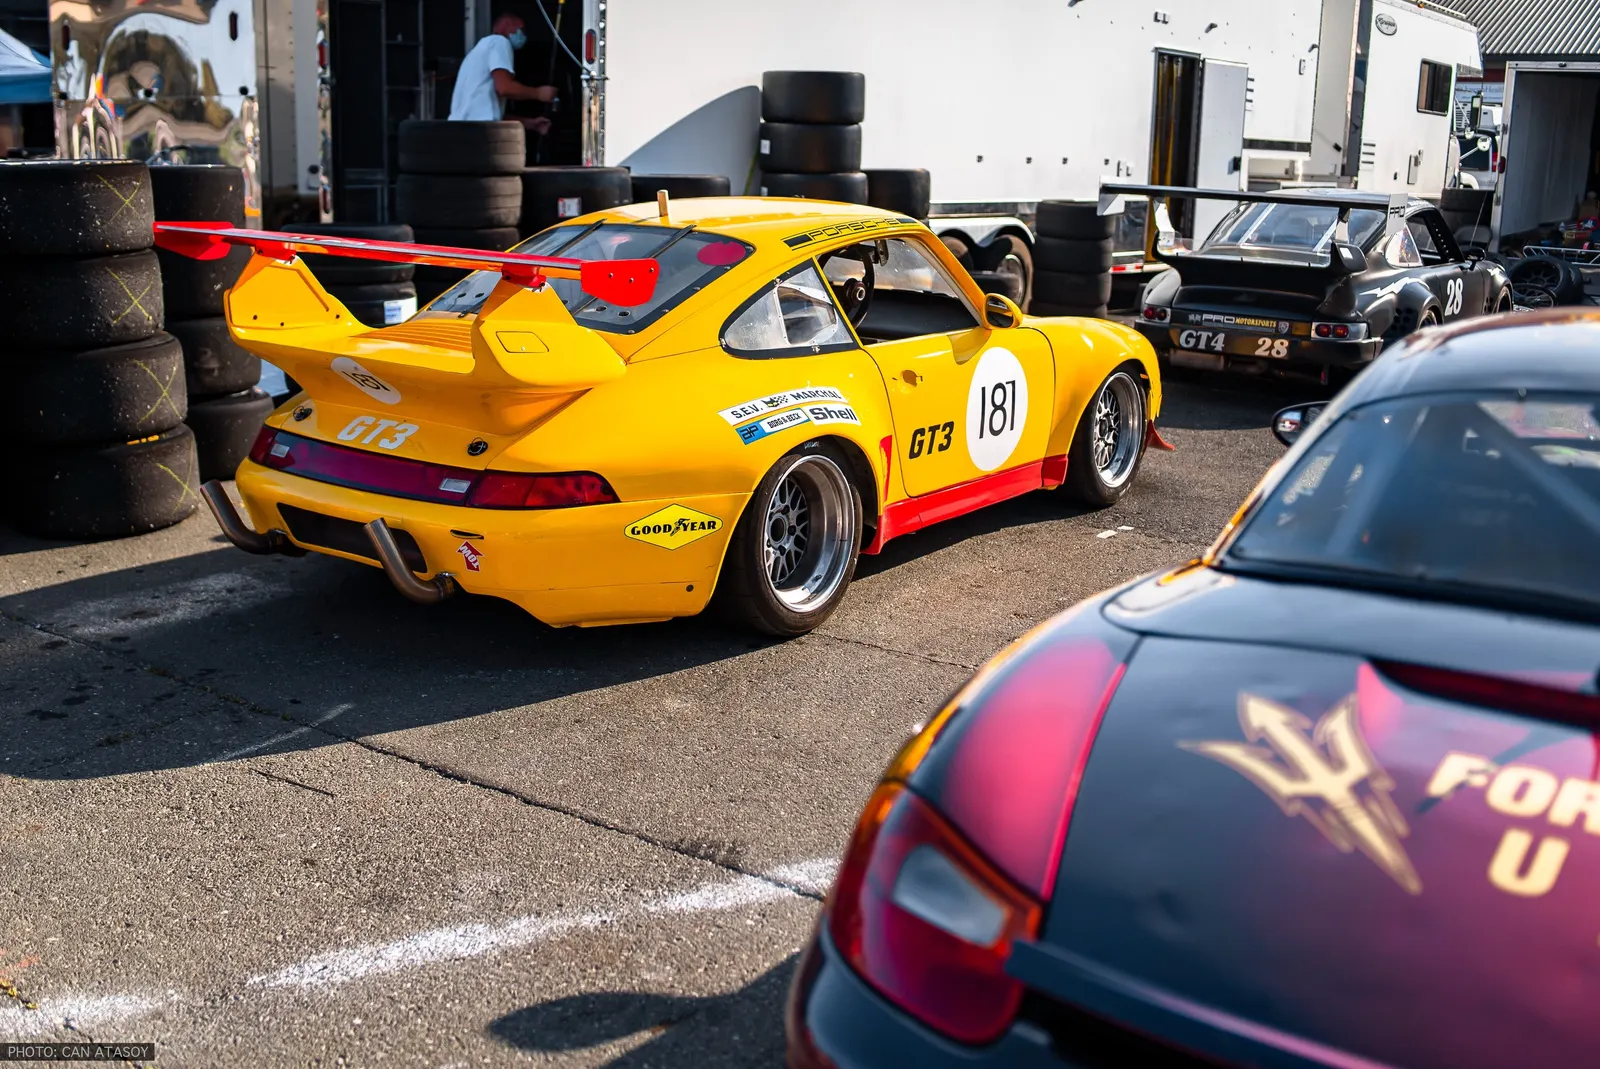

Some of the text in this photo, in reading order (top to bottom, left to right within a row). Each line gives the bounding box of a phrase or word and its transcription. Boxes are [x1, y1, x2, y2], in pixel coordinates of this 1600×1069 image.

[808, 219, 899, 240] PORSCHE
[1444, 277, 1464, 317] 28
[1202, 313, 1235, 324] PRO
[1235, 316, 1277, 328] MOTORSPORTS
[1180, 329, 1289, 358] GT4 28
[341, 370, 391, 392] 181
[731, 389, 842, 419] S.E.V. MARCHAL
[809, 406, 858, 421] Shell
[979, 380, 1016, 439] 181
[337, 415, 419, 450] GT3
[766, 417, 784, 429] BORG
[788, 412, 803, 422] BECK
[908, 420, 955, 460] GT3
[460, 545, 479, 569] TOW
